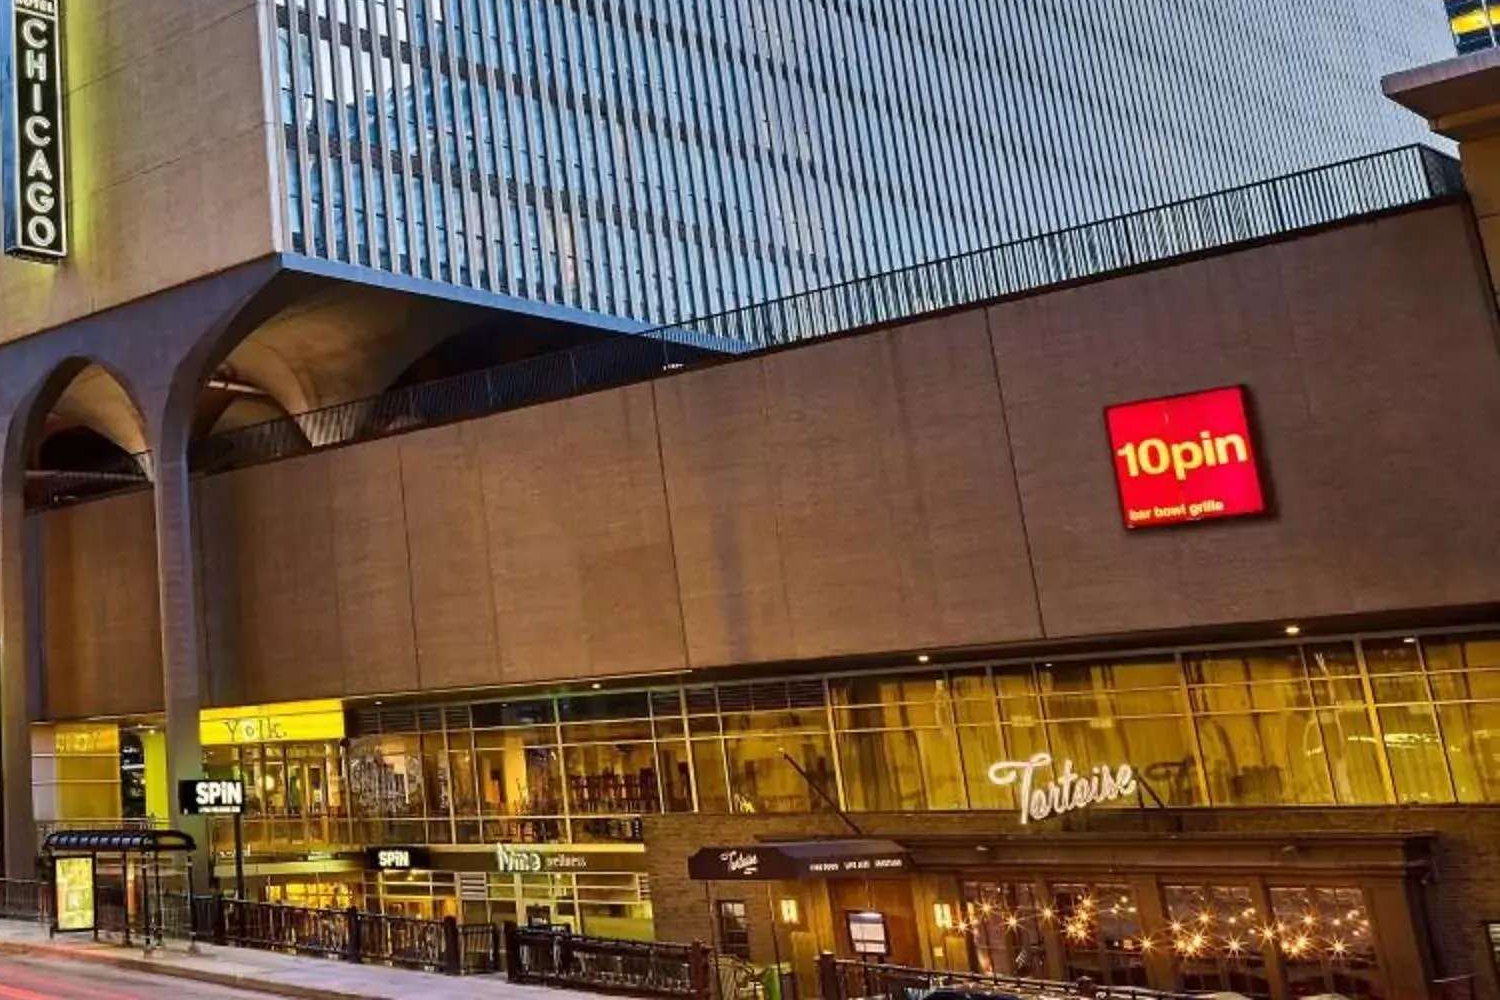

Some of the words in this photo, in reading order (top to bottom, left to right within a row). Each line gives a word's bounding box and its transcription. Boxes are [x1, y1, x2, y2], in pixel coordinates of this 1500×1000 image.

[22, 18, 56, 248] CHICAGO
[1116, 430, 1248, 481] 10pin
[1153, 503, 1187, 517] bowl
[1189, 500, 1224, 517] grille
[987, 752, 1137, 825] Tortoise
